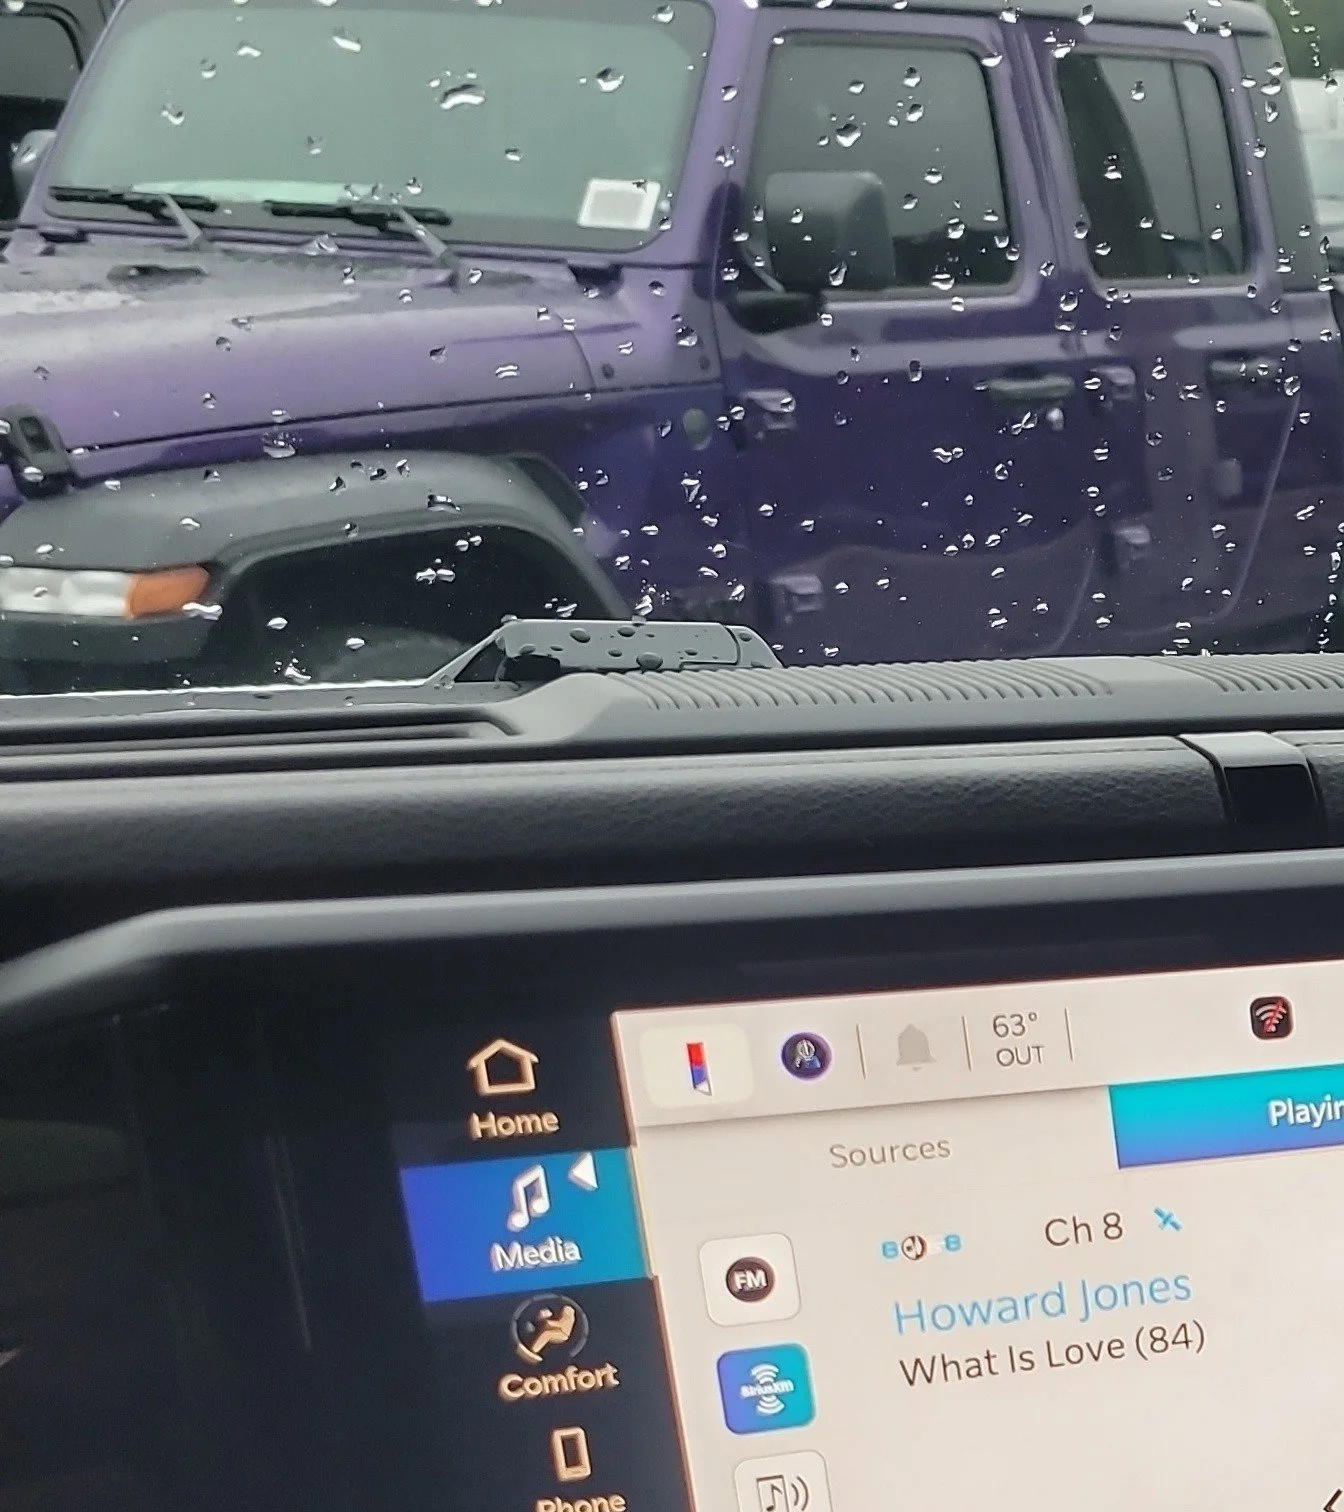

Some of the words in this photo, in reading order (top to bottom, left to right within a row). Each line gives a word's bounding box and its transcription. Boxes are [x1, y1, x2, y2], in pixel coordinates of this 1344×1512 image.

[995, 1045, 1046, 1068] OUT
[468, 1110, 560, 1140] Home
[828, 1138, 952, 1169] Sources
[1044, 1215, 1094, 1247] Ch
[1103, 1211, 1124, 1241] 8
[490, 1236, 582, 1271] Media
[733, 1270, 768, 1293] FM
[893, 1280, 1068, 1336] Howard
[1079, 1272, 1193, 1323] Jones
[898, 1348, 1000, 1388] What
[1008, 1344, 1036, 1374] Is
[1045, 1337, 1127, 1369] Love
[1134, 1319, 1207, 1362] (84)
[499, 1361, 621, 1401] Comfort
